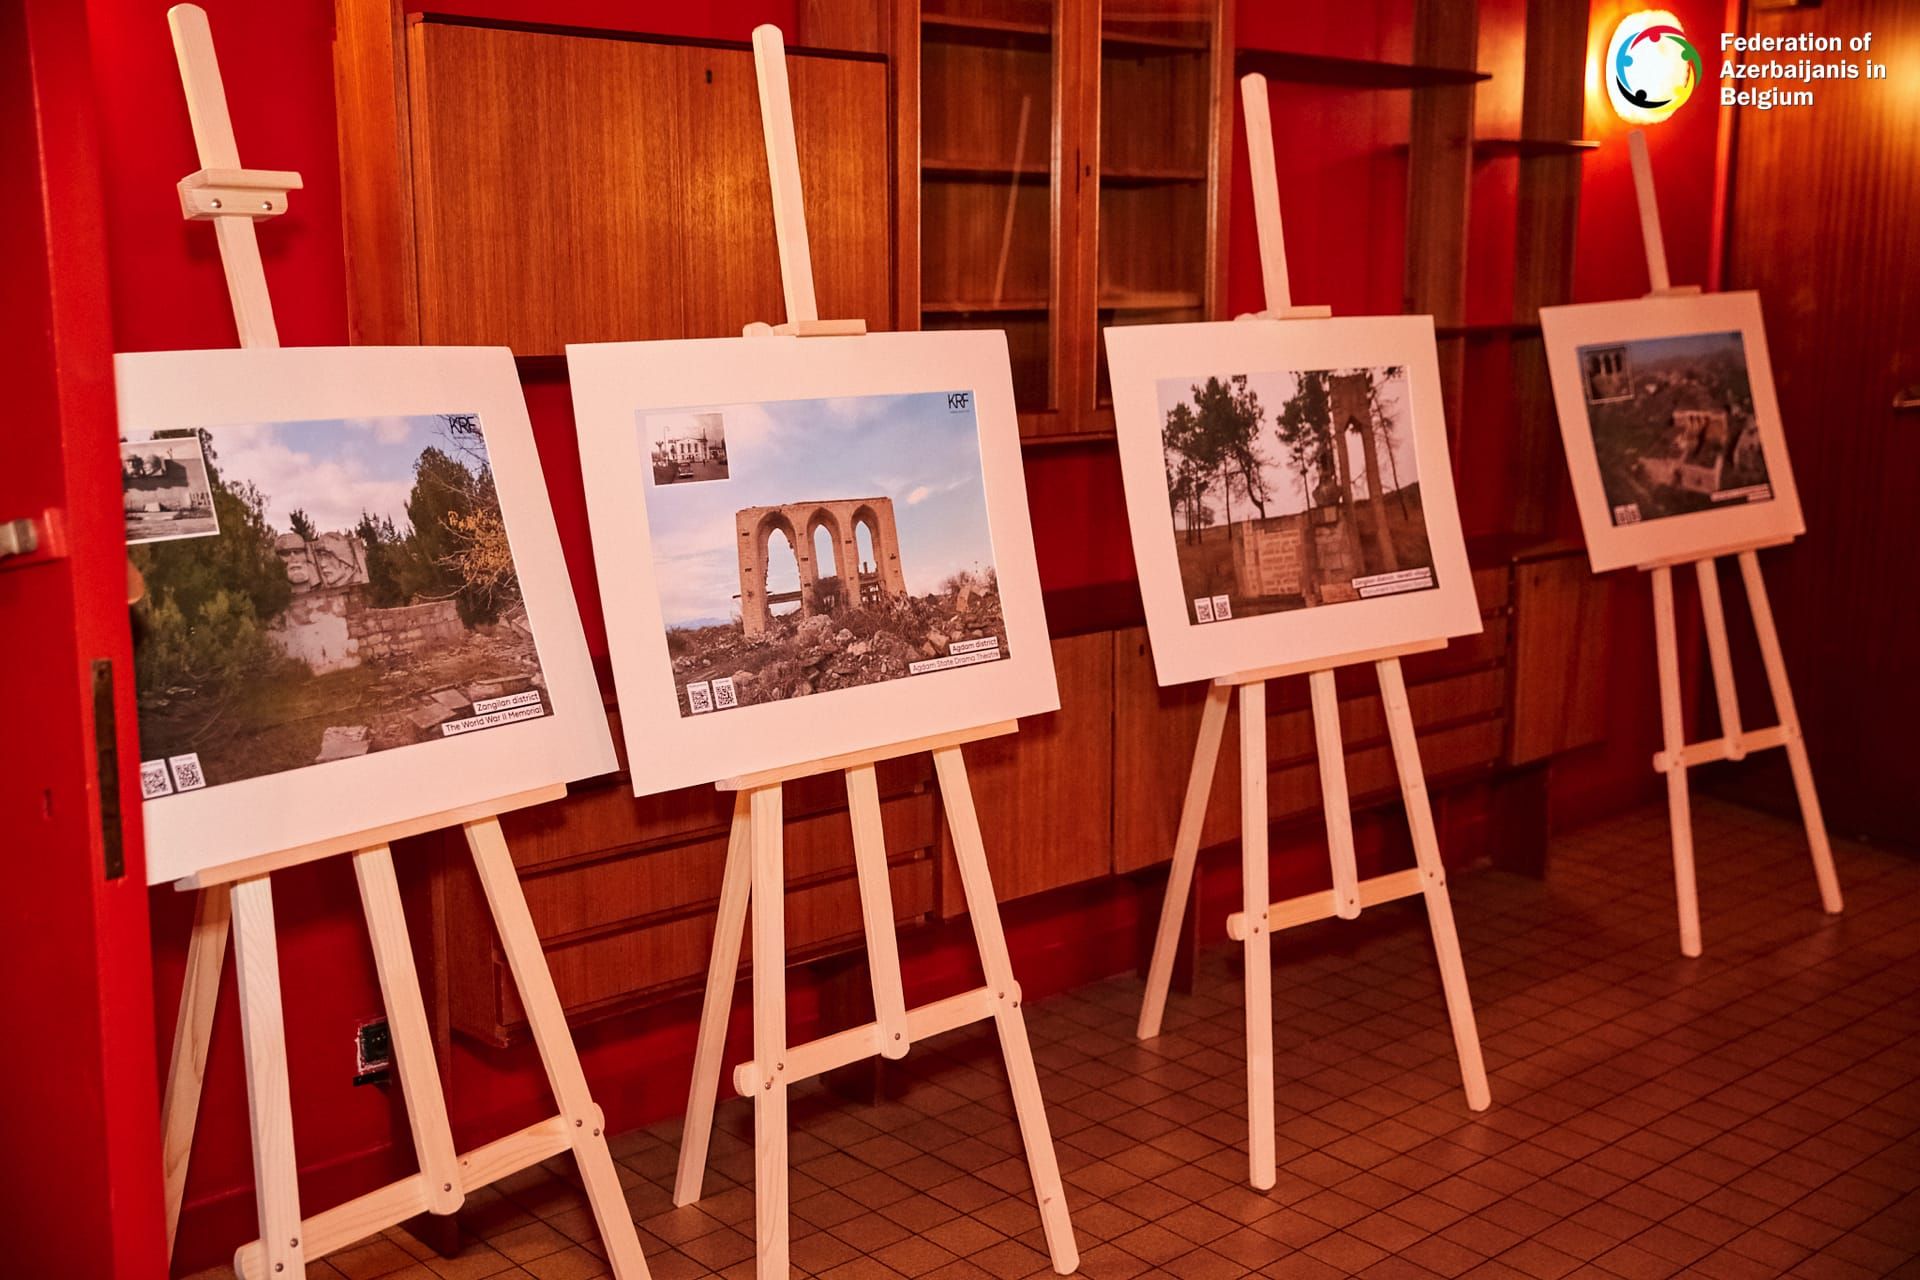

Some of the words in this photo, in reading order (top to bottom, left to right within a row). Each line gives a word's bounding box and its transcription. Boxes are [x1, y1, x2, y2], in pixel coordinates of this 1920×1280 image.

[948, 393, 969, 408] KRF
[448, 417, 476, 434] KRF
[952, 641, 975, 652] Agdam
[976, 638, 997, 648] district
[913, 662, 937, 672] Agdam
[937, 658, 954, 667] State
[955, 655, 976, 664] Drama
[976, 651, 999, 660] Theatre
[477, 698, 511, 712] Zangilan
[512, 693, 539, 704] district
[446, 723, 461, 732] The
[461, 718, 484, 729] World
[485, 715, 501, 724] War
[508, 706, 543, 719] Memorial
